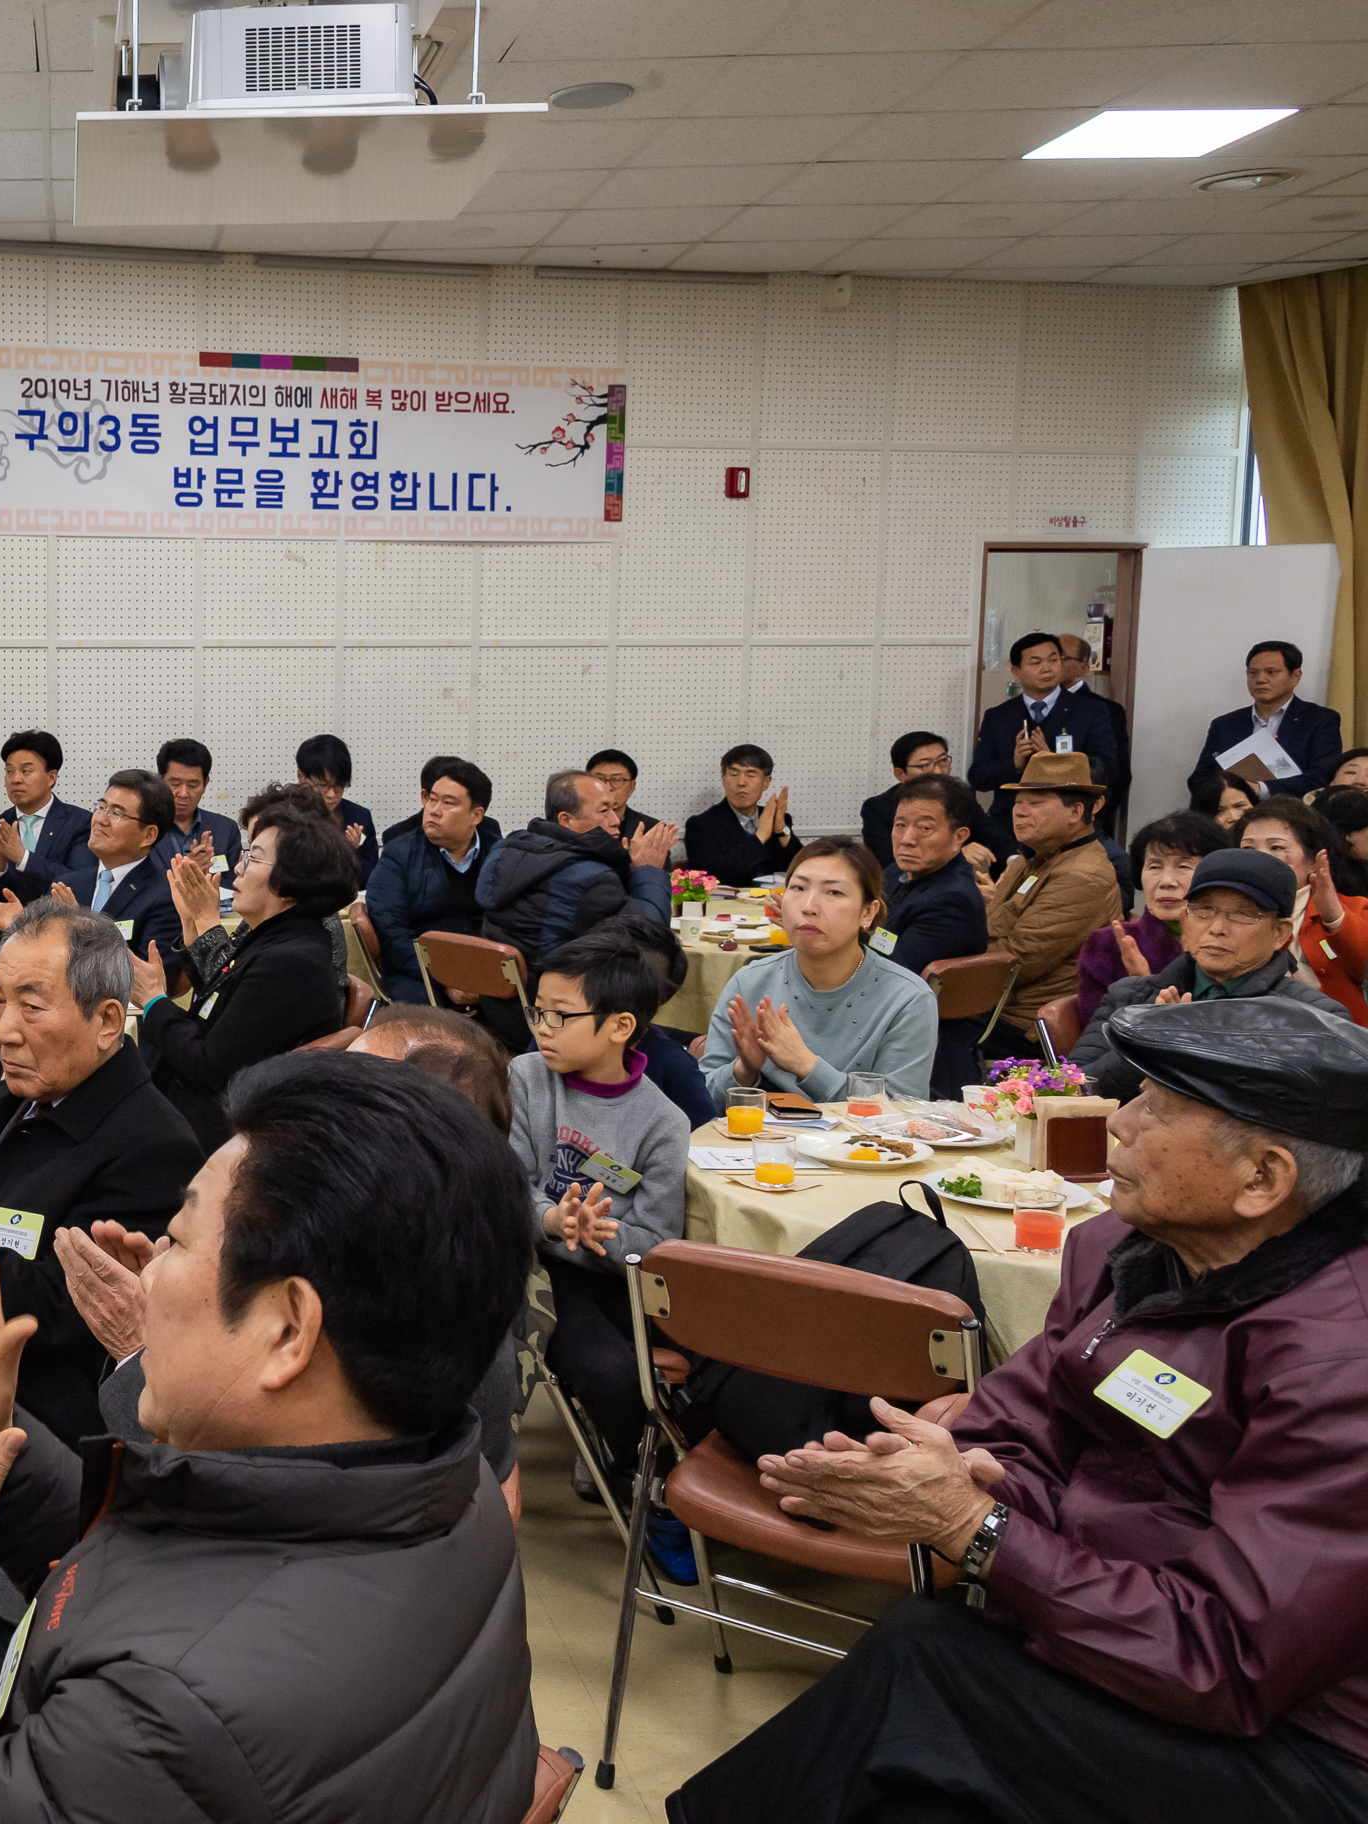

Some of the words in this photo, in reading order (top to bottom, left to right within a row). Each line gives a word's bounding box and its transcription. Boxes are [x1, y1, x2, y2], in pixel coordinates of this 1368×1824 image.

[20, 378, 92, 402] 2019년
[101, 379, 162, 404] 기해년
[168, 380, 267, 408] 황금돼지의
[274, 384, 313, 409] 해에
[319, 386, 358, 411] 새해
[365, 387, 384, 412] 복
[391, 388, 427, 413] 많이
[433, 389, 516, 414] 받으세요.
[13, 410, 163, 455] 구의3동
[187, 416, 380, 461] 업무보고회
[172, 466, 286, 508] 방문을
[309, 468, 513, 513] 환영합니다.
[1048, 515, 1087, 528] 비상탈출구
[556, 1126, 615, 1160] OOKL
